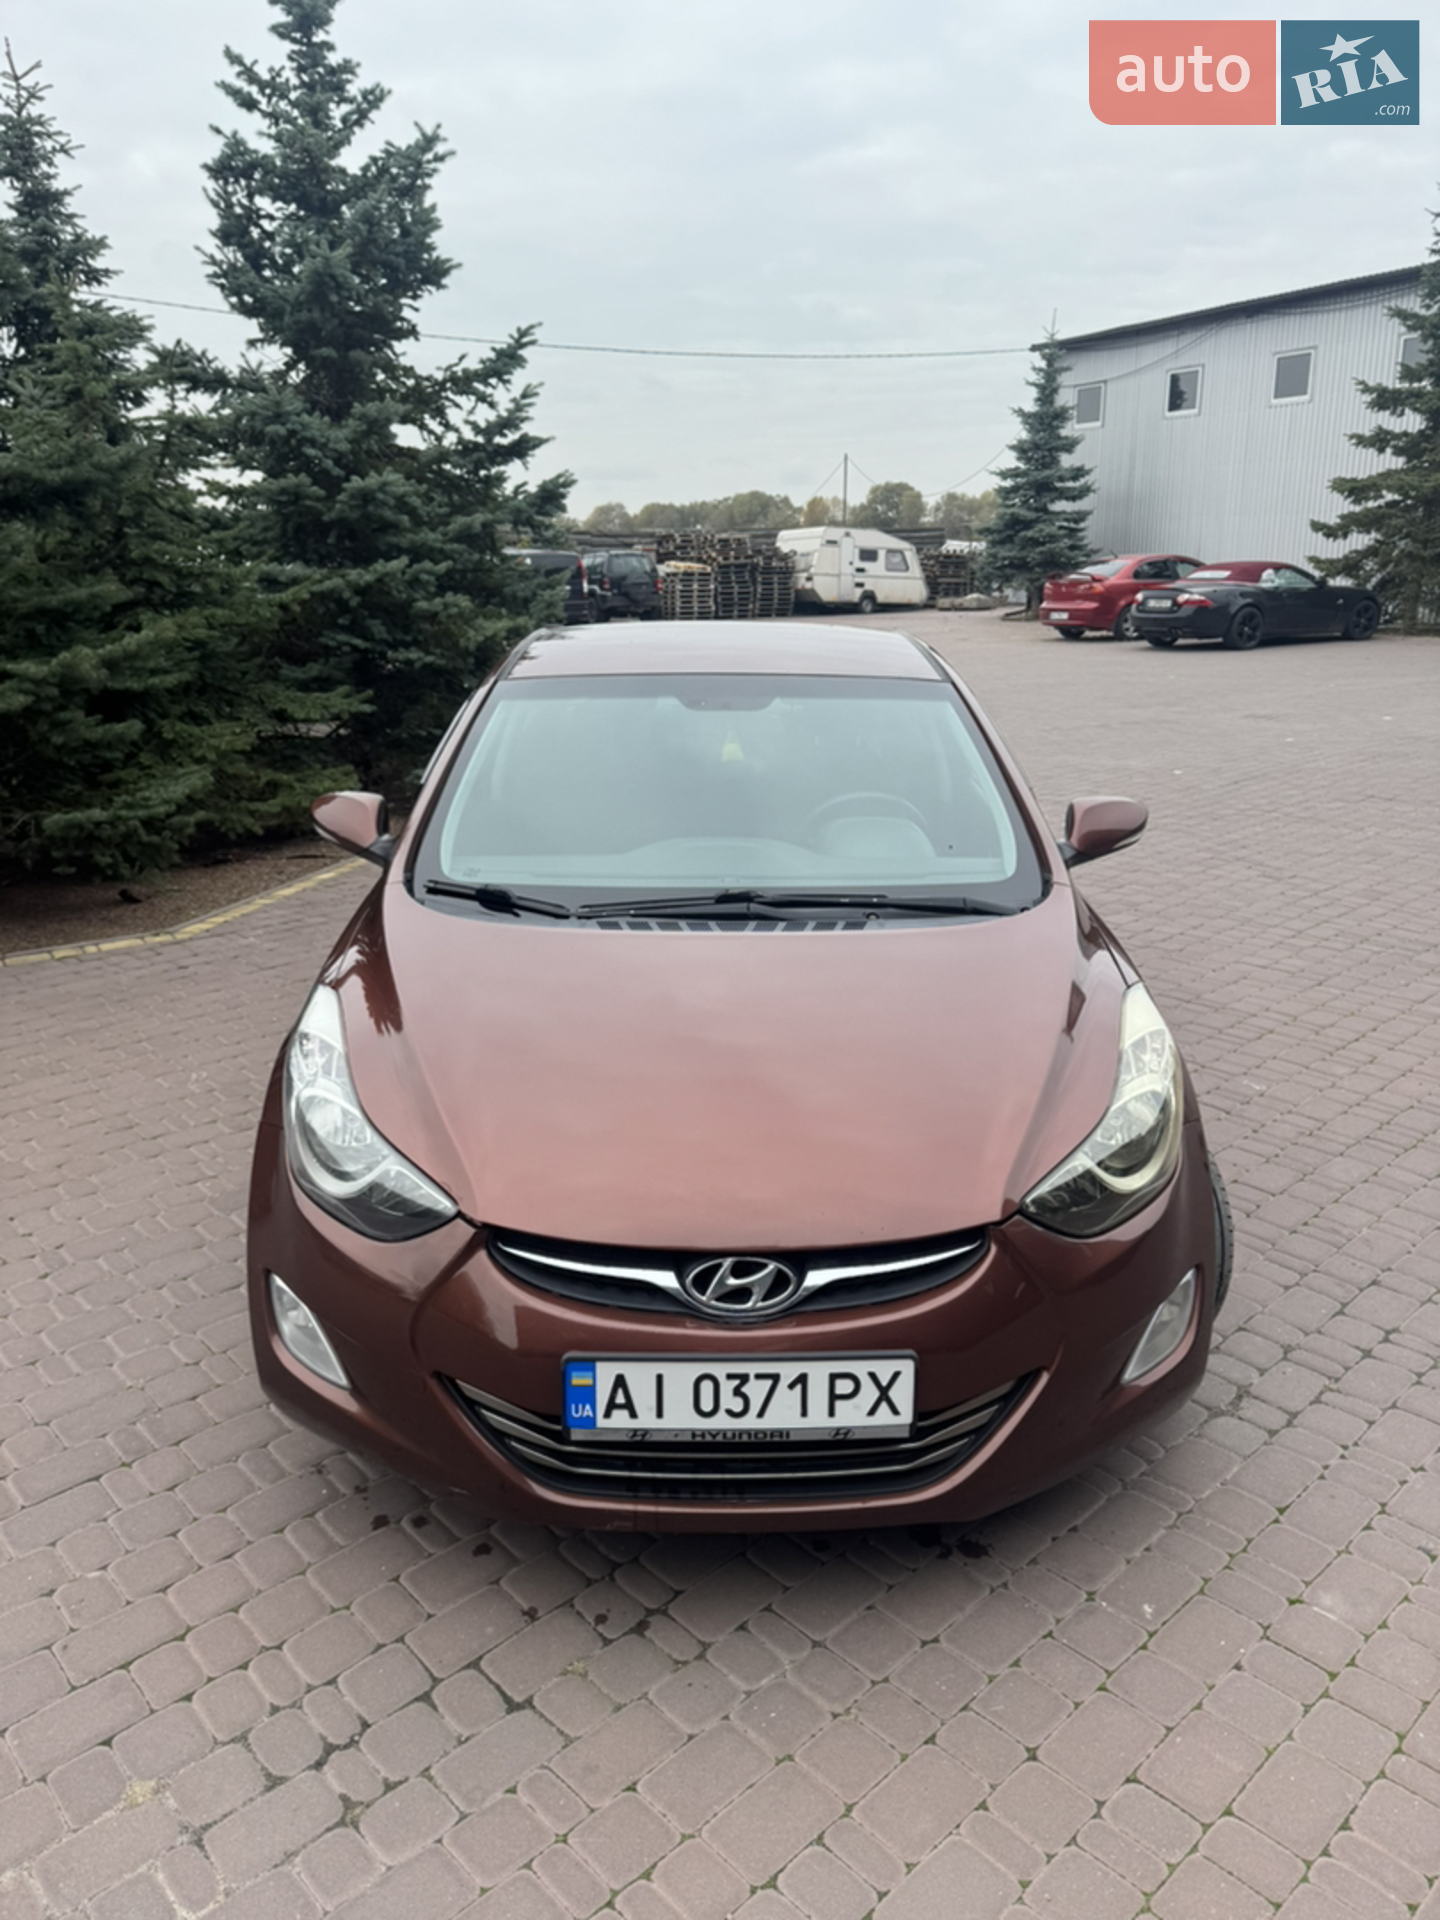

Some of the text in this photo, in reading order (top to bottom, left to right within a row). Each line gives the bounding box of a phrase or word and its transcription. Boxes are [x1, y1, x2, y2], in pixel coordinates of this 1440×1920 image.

[602, 1373, 665, 1420] AI
[571, 1404, 594, 1419] UA
[690, 1429, 791, 1441] HYUNDAI
